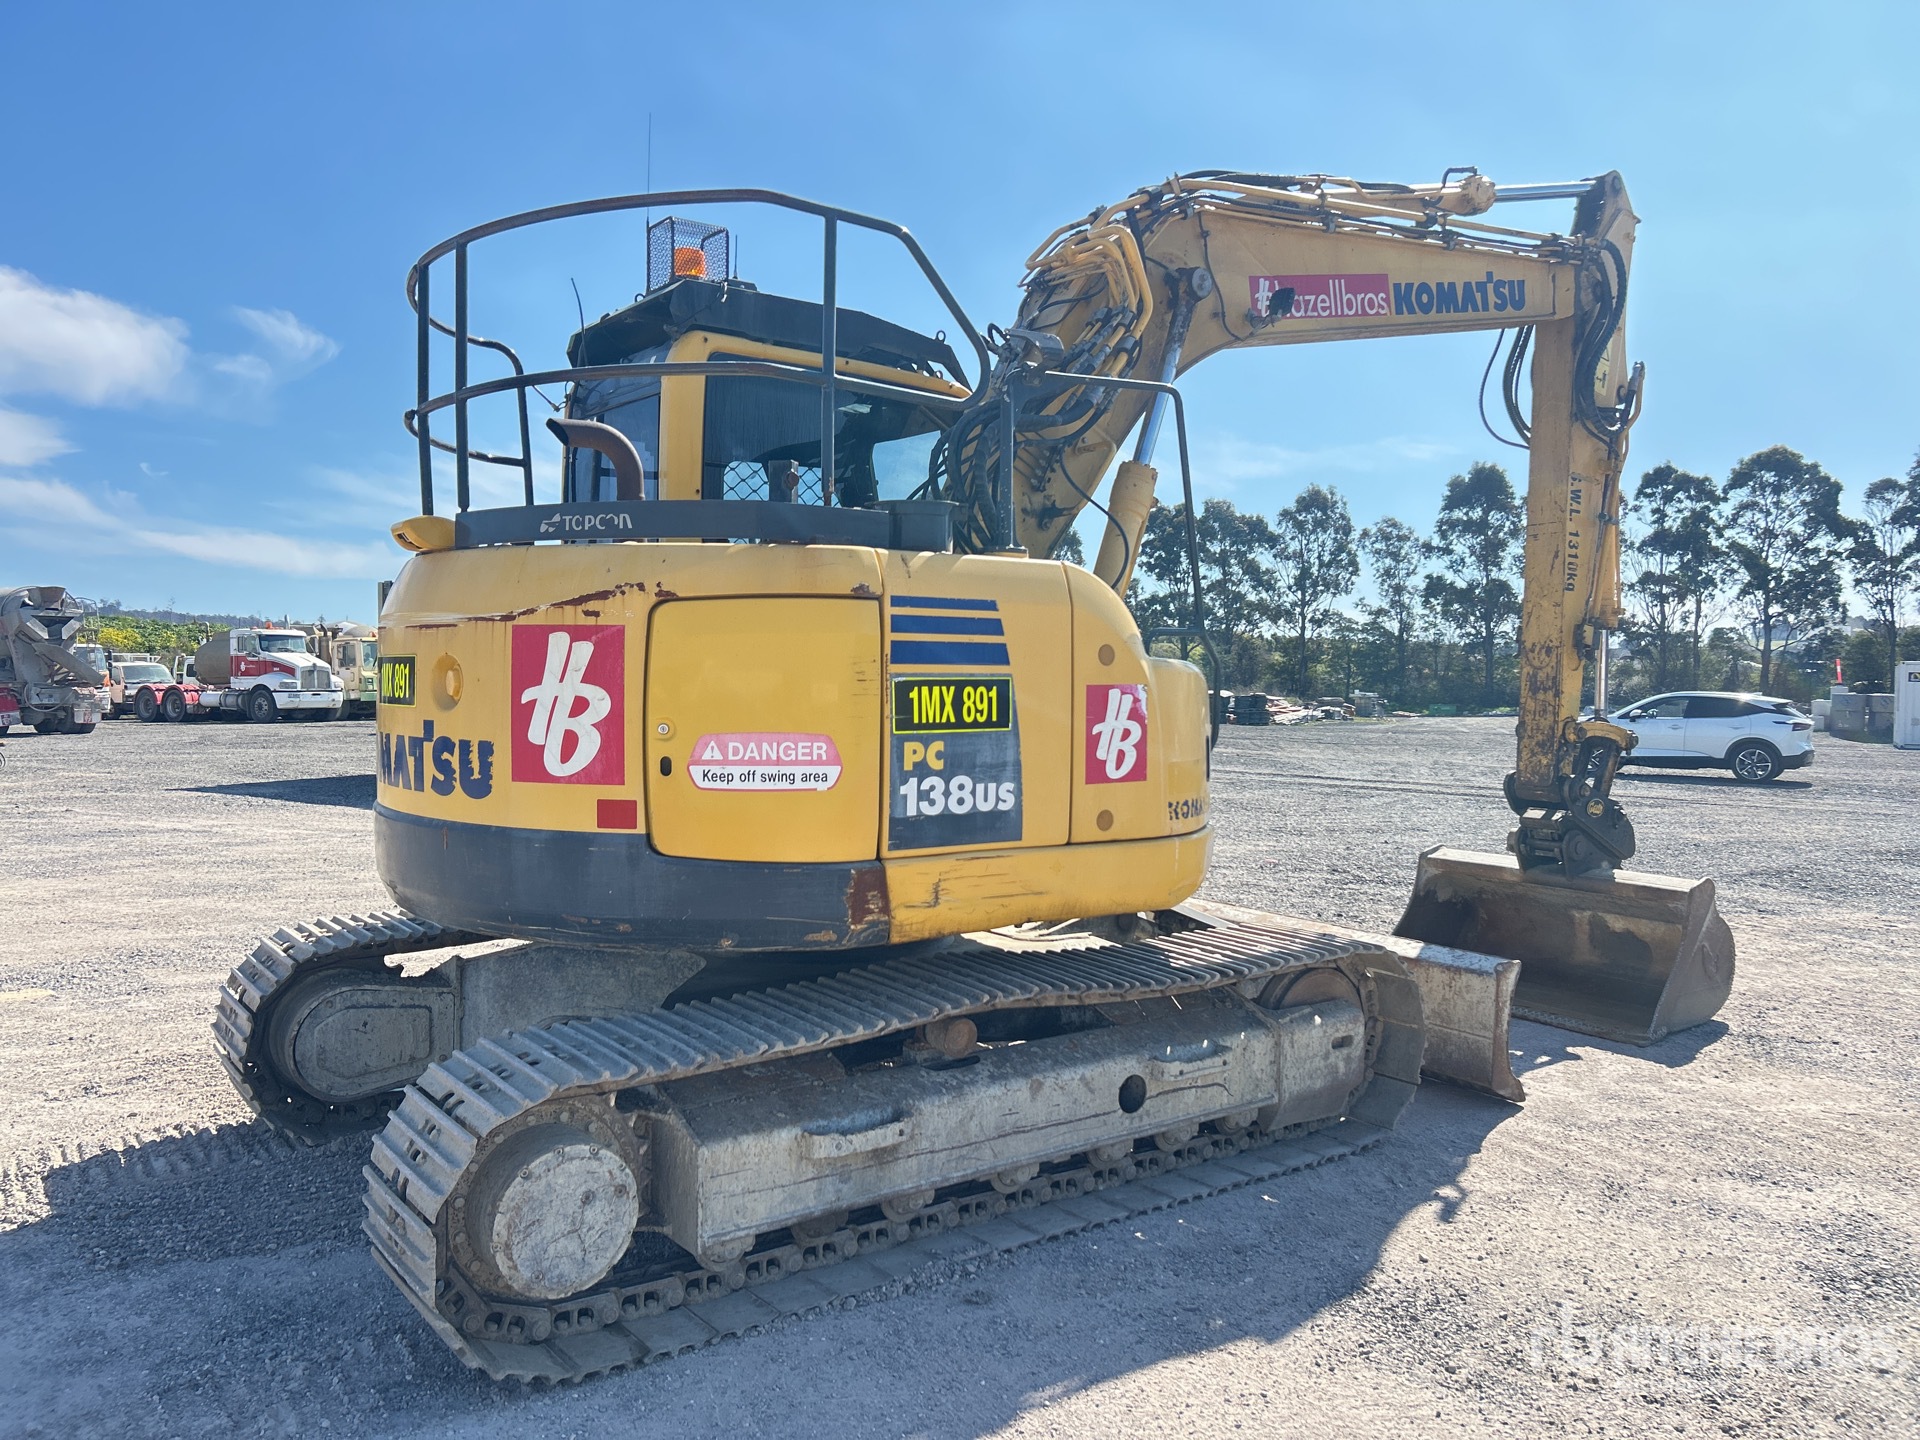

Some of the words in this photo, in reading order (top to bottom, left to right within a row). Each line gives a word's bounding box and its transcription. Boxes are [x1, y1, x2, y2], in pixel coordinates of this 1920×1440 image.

[1393, 271, 1525, 315] KOMATSU
[394, 663, 410, 698] 891
[909, 686, 956, 723] 1MX
[962, 686, 998, 723] 891
[728, 741, 827, 761] DANGER
[903, 741, 945, 771] PC
[702, 769, 734, 784] Keep
[739, 769, 756, 782] off
[760, 770, 796, 784] swing
[800, 773, 828, 782] area
